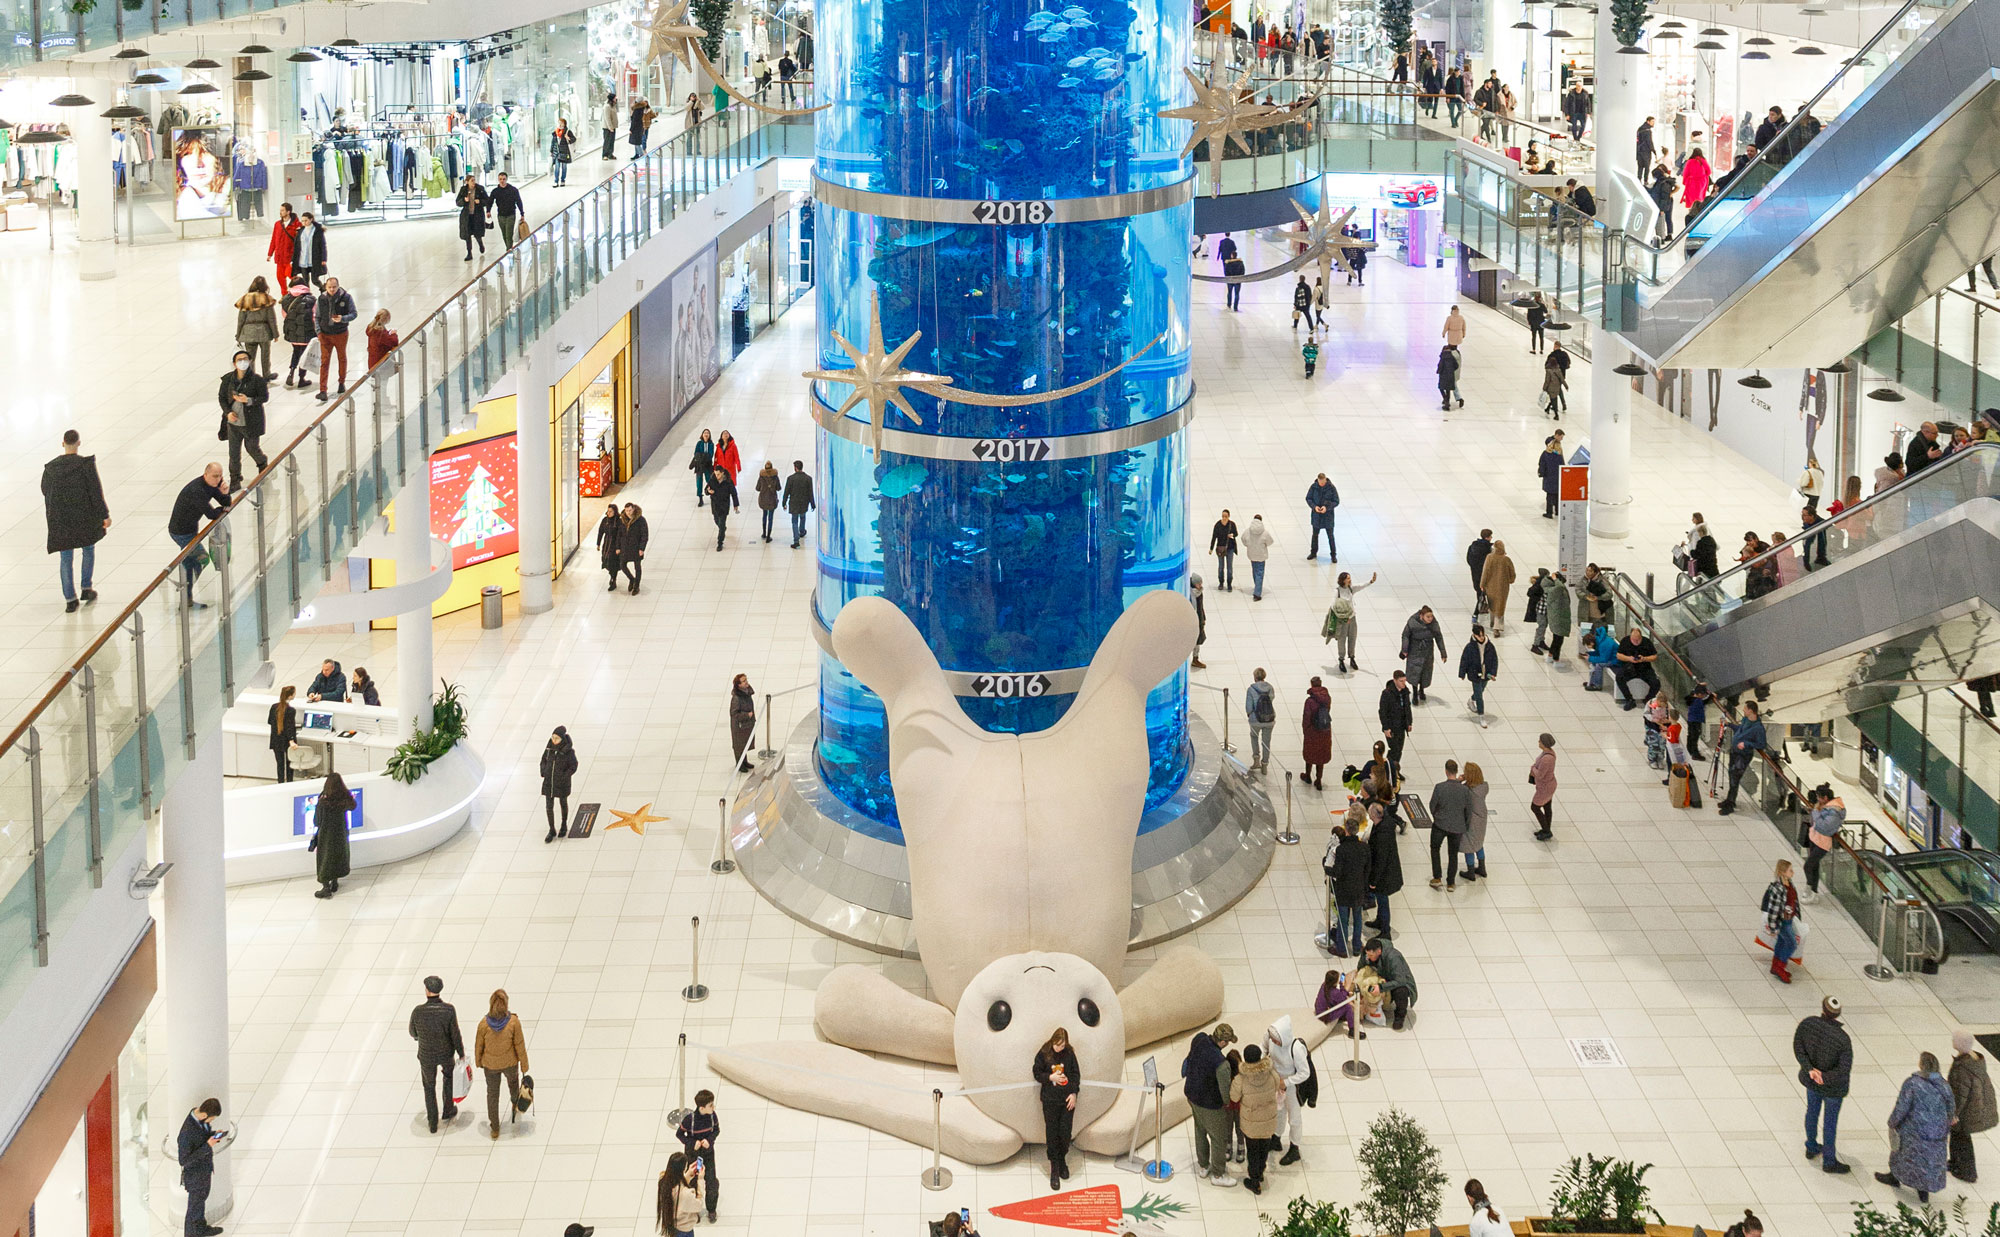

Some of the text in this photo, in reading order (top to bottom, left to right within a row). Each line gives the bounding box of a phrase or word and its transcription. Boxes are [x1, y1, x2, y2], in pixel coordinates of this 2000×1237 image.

[981, 201, 1045, 224] 2018
[981, 439, 1042, 462] 2017
[1579, 486, 1586, 499] 1
[979, 674, 1043, 697] 2016
